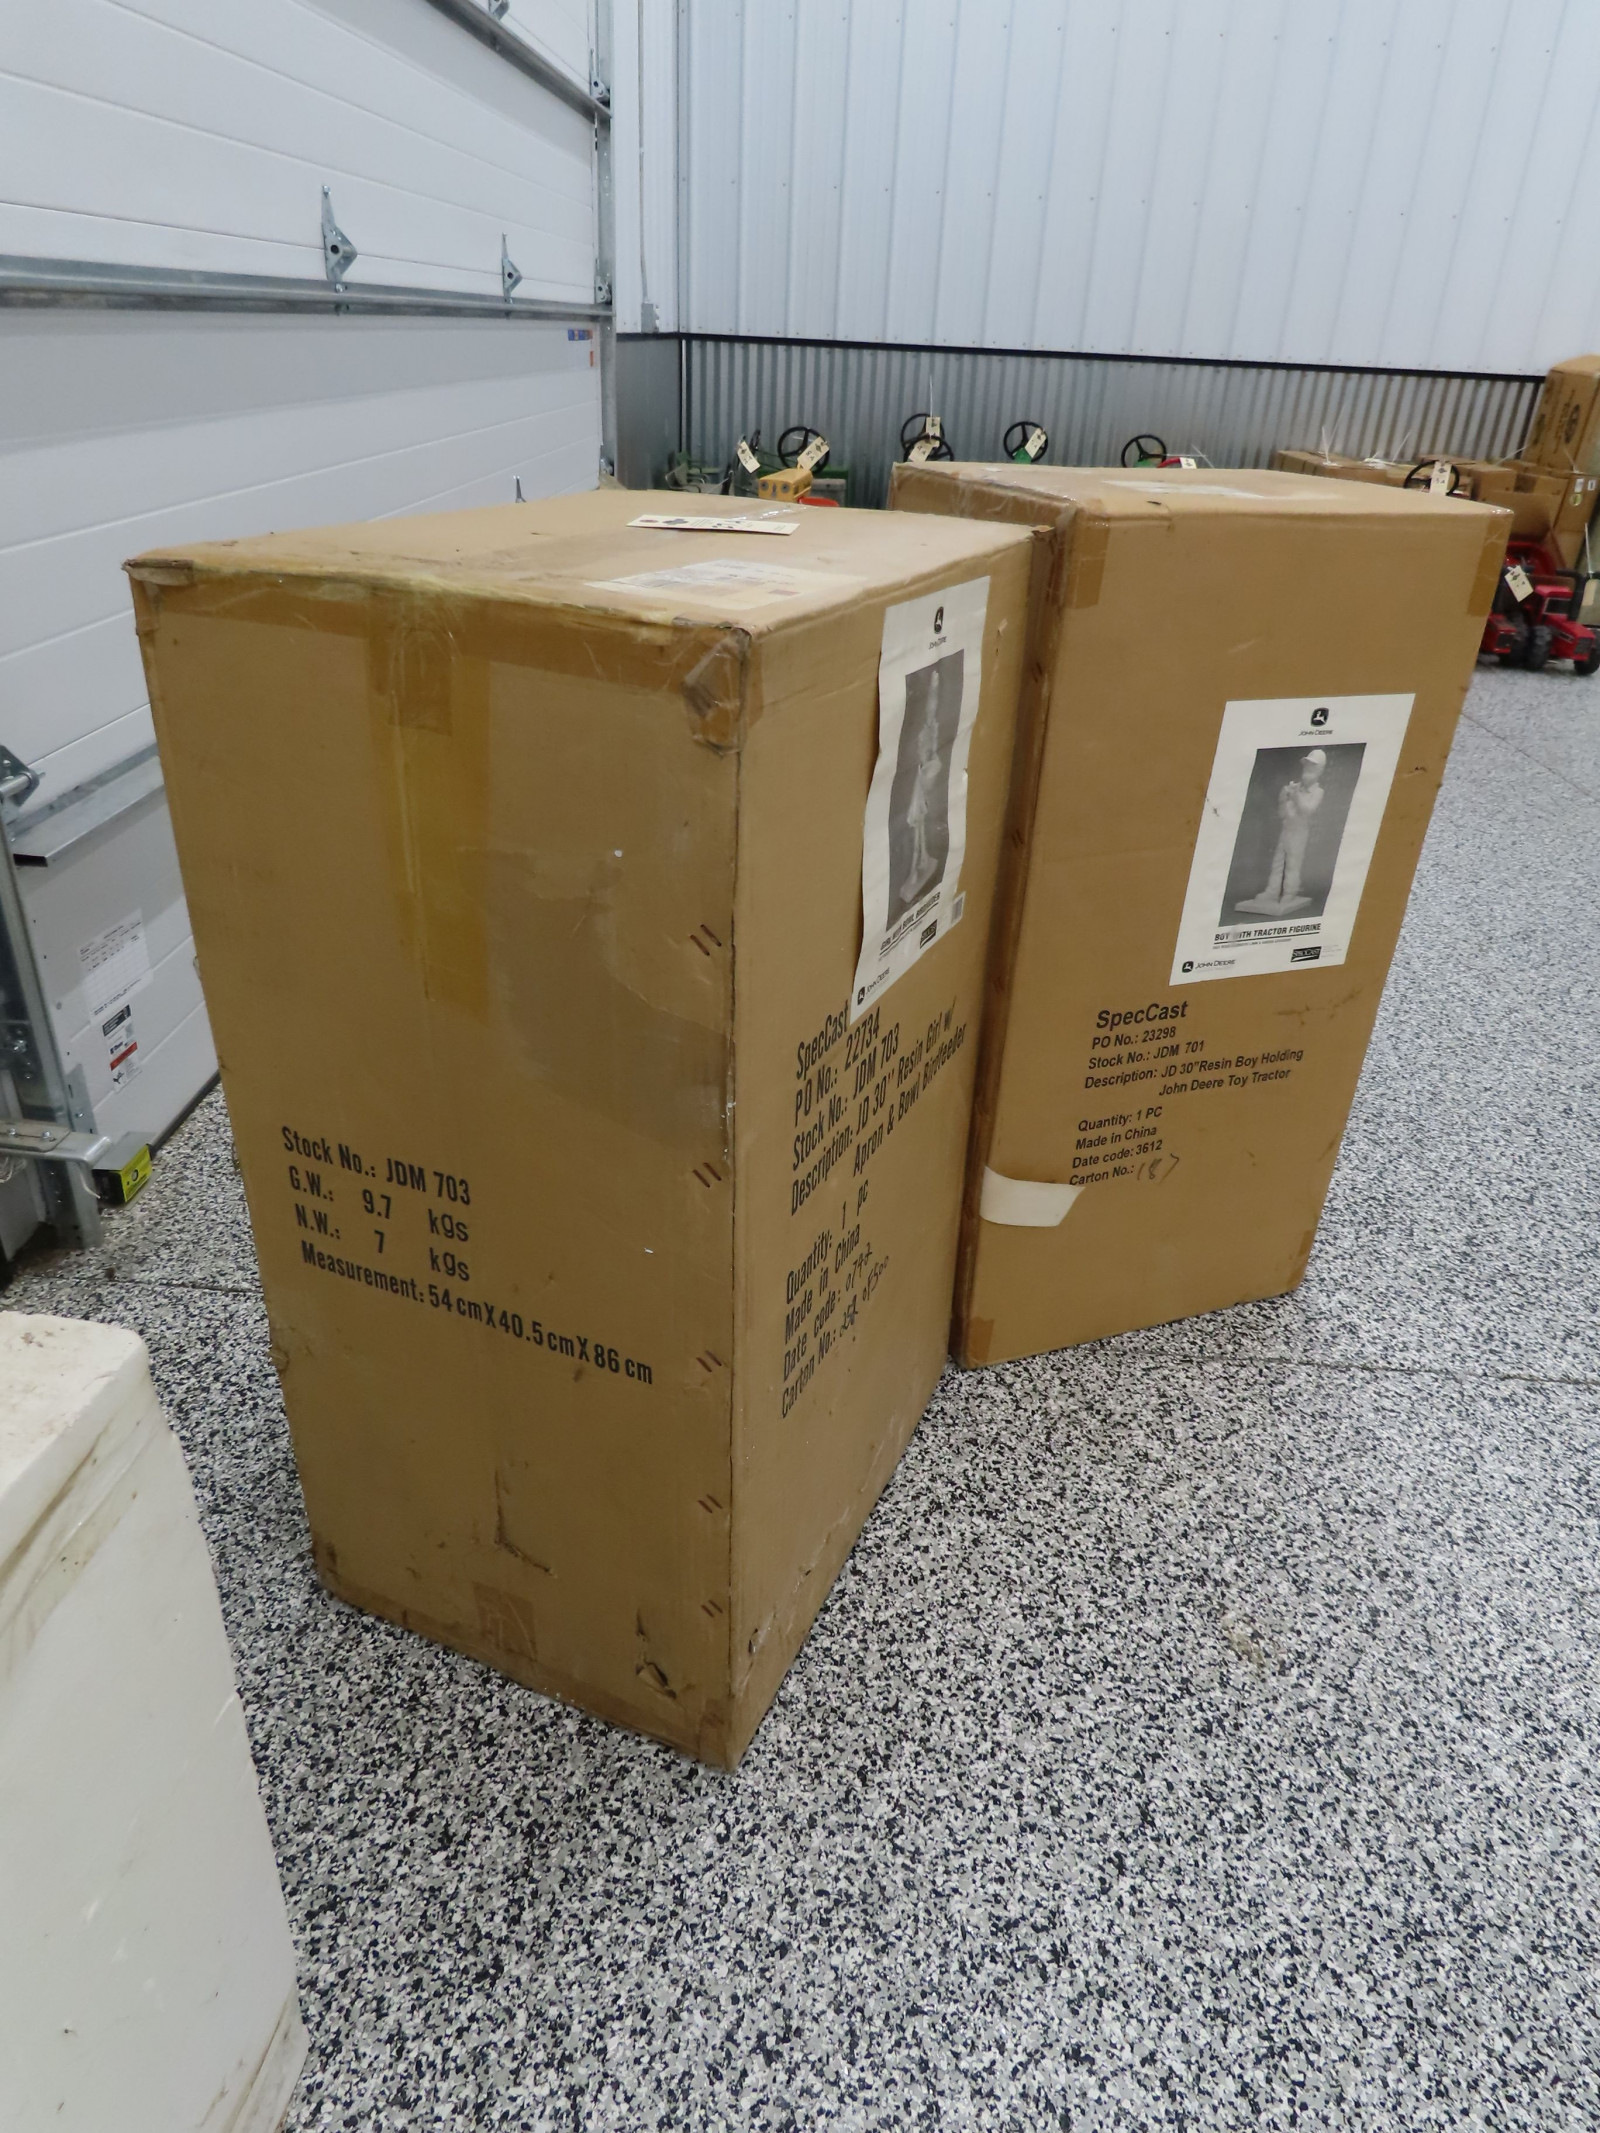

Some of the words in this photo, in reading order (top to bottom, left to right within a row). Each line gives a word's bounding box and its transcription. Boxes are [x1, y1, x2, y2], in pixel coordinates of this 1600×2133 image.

[1253, 927, 1288, 937] TRACTOR
[1288, 923, 1322, 934] FIGURINE
[796, 998, 849, 1081] SpecCast
[1092, 1036, 1110, 1050] PO
[1114, 1033, 1139, 1048] No.:
[1141, 1026, 1176, 1043] 23298
[1096, 1001, 1189, 1031] SpecCast
[816, 1064, 838, 1104] No.:
[844, 1006, 880, 1072] 22734
[1084, 1067, 1158, 1089] Description:
[1161, 1065, 1177, 1078] JD
[1235, 1055, 1258, 1070] Boy
[1261, 1049, 1304, 1067] Holding
[1088, 1054, 1123, 1070] Stock
[1126, 1050, 1151, 1065] No.:
[1153, 1044, 1180, 1059] JDM
[1185, 1040, 1205, 1054] 701
[1158, 1083, 1187, 1096] John
[1190, 1077, 1224, 1091] Deere
[1228, 1074, 1249, 1089] Toy
[1252, 1068, 1291, 1083] Tractor
[791, 1125, 854, 1216] Description:
[856, 1095, 870, 1136] JD
[897, 1039, 923, 1089] Resin
[925, 1011, 943, 1054] Girl
[793, 1110, 825, 1171] Stock
[828, 1094, 848, 1132] No.:
[853, 1046, 877, 1100] JDM
[880, 1022, 900, 1069] 703
[853, 1122, 884, 1178] Apron
[886, 1103, 895, 1135] &
[898, 1071, 921, 1122] Bowl
[922, 1022, 967, 1092] Birdfeeder
[1078, 1112, 1133, 1132] Quantity:
[1136, 1109, 1142, 1121] 1
[1145, 1106, 1163, 1119] PC
[281, 1126, 334, 1165] Stock
[338, 1143, 377, 1178] No.:
[386, 1158, 427, 1194] JDM
[433, 1171, 471, 1206] 703
[1069, 1170, 1109, 1186] Carton
[1112, 1164, 1135, 1179] No.:
[1072, 1155, 1100, 1169] Date
[1103, 1147, 1134, 1164] code:
[1135, 1139, 1163, 1155] 3612
[1075, 1135, 1108, 1151] Made
[1111, 1131, 1121, 1145] in
[1125, 1125, 1157, 1141] China
[289, 1165, 334, 1202] G.W.:
[362, 1188, 392, 1220] 9.7
[428, 1208, 470, 1242] kgs
[786, 1228, 832, 1305] Quantity:
[842, 1200, 847, 1230] 1
[857, 1179, 869, 1216] pc
[295, 1203, 341, 1240] N.W.:
[374, 1230, 385, 1254] 7
[429, 1247, 470, 1282] kgs
[301, 1240, 425, 1303] Measurement:
[785, 1289, 813, 1345] Made
[819, 1266, 829, 1297] in
[834, 1223, 861, 1274] China
[781, 1354, 815, 1419] Carton
[818, 1328, 837, 1365] No.:
[784, 1332, 807, 1383] Date
[813, 1289, 841, 1338] code:
